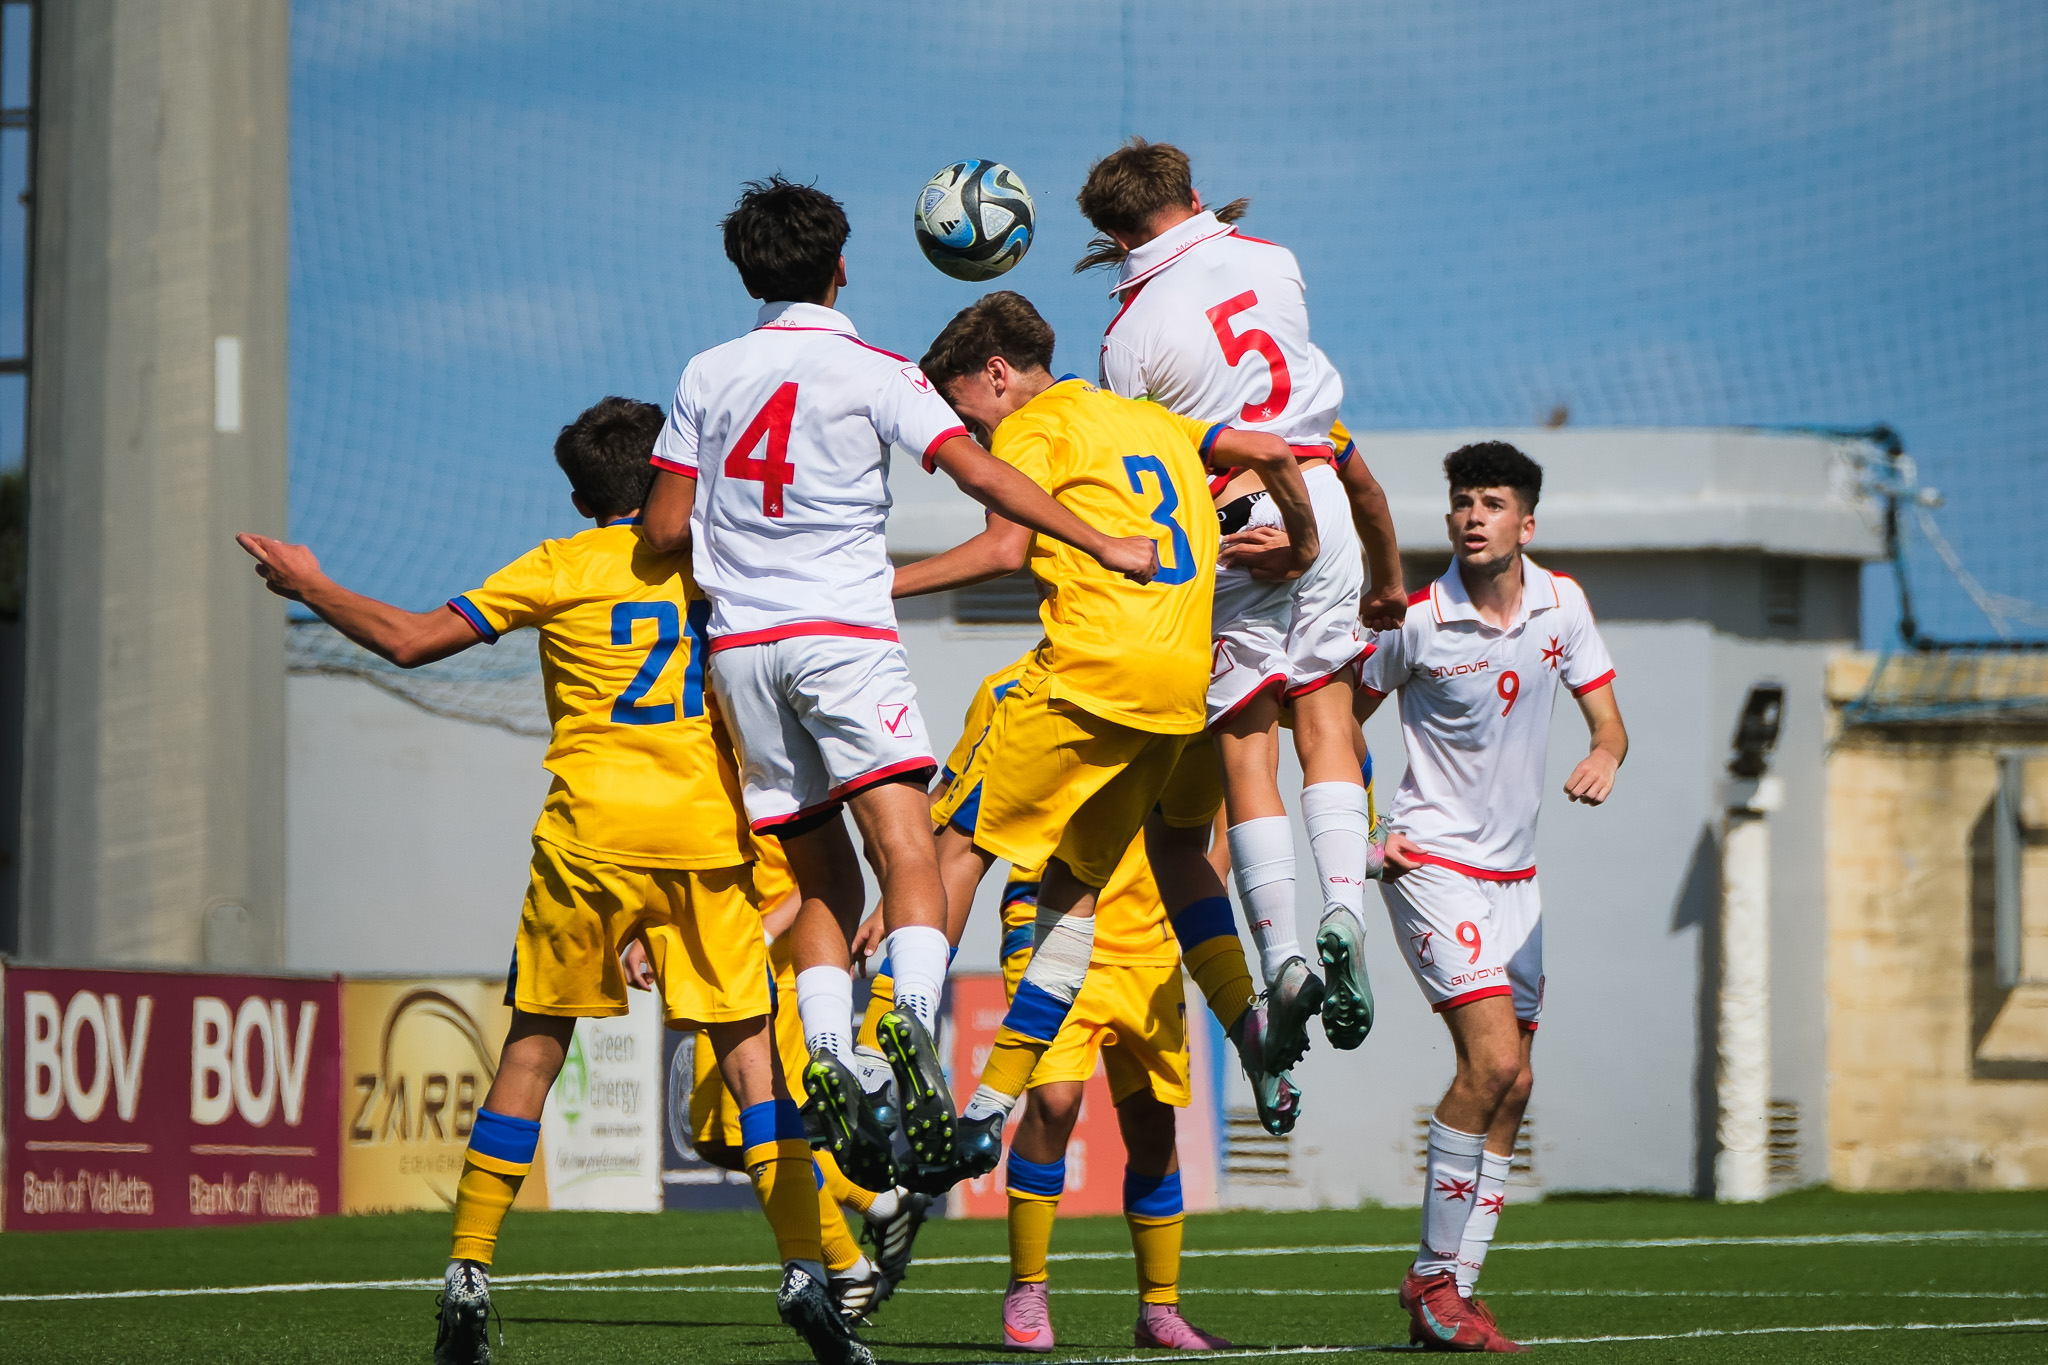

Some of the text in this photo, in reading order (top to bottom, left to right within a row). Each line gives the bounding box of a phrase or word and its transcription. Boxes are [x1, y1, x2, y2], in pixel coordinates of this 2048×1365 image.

[1175, 233, 1206, 252] MALTA
[1205, 289, 1292, 422] 5
[724, 381, 799, 518] 4
[1122, 455, 1197, 585] 3
[611, 599, 709, 725] 21
[1429, 660, 1489, 678] GIVOVA
[1497, 670, 1520, 717] 9
[1455, 921, 1482, 965] 9
[24, 989, 154, 1124] BOV
[190, 995, 319, 1127] BOV
[589, 1024, 635, 1063] Green
[590, 1070, 641, 1116] Energy
[23, 1168, 64, 1214] Bank
[65, 1168, 89, 1213] of
[189, 1171, 235, 1215] Bank
